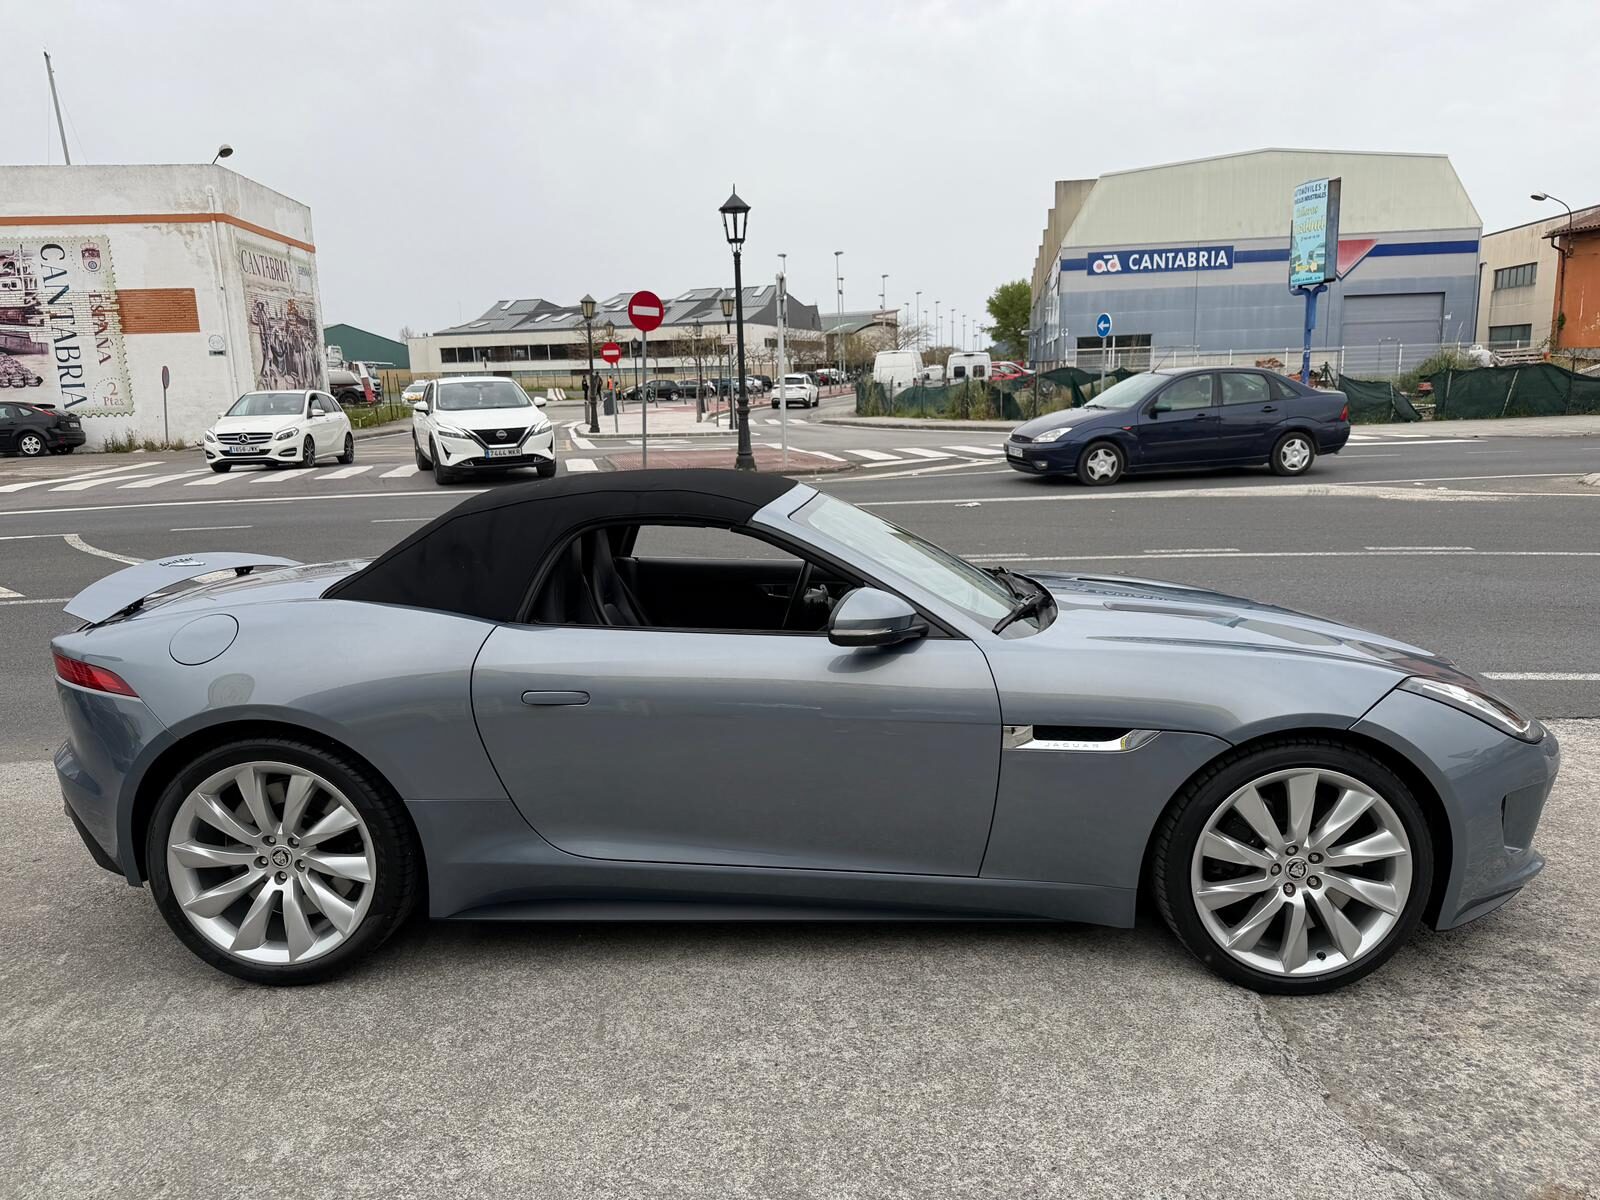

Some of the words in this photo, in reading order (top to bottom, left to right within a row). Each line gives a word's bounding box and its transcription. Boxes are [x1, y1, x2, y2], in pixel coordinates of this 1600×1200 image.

[241, 249, 290, 282] CANTABRIA
[1129, 250, 1228, 270] CANTABRIA
[40, 243, 87, 409] CANTABRIA
[89, 294, 112, 364] ESPAÑA
[107, 382, 118, 395] 2
